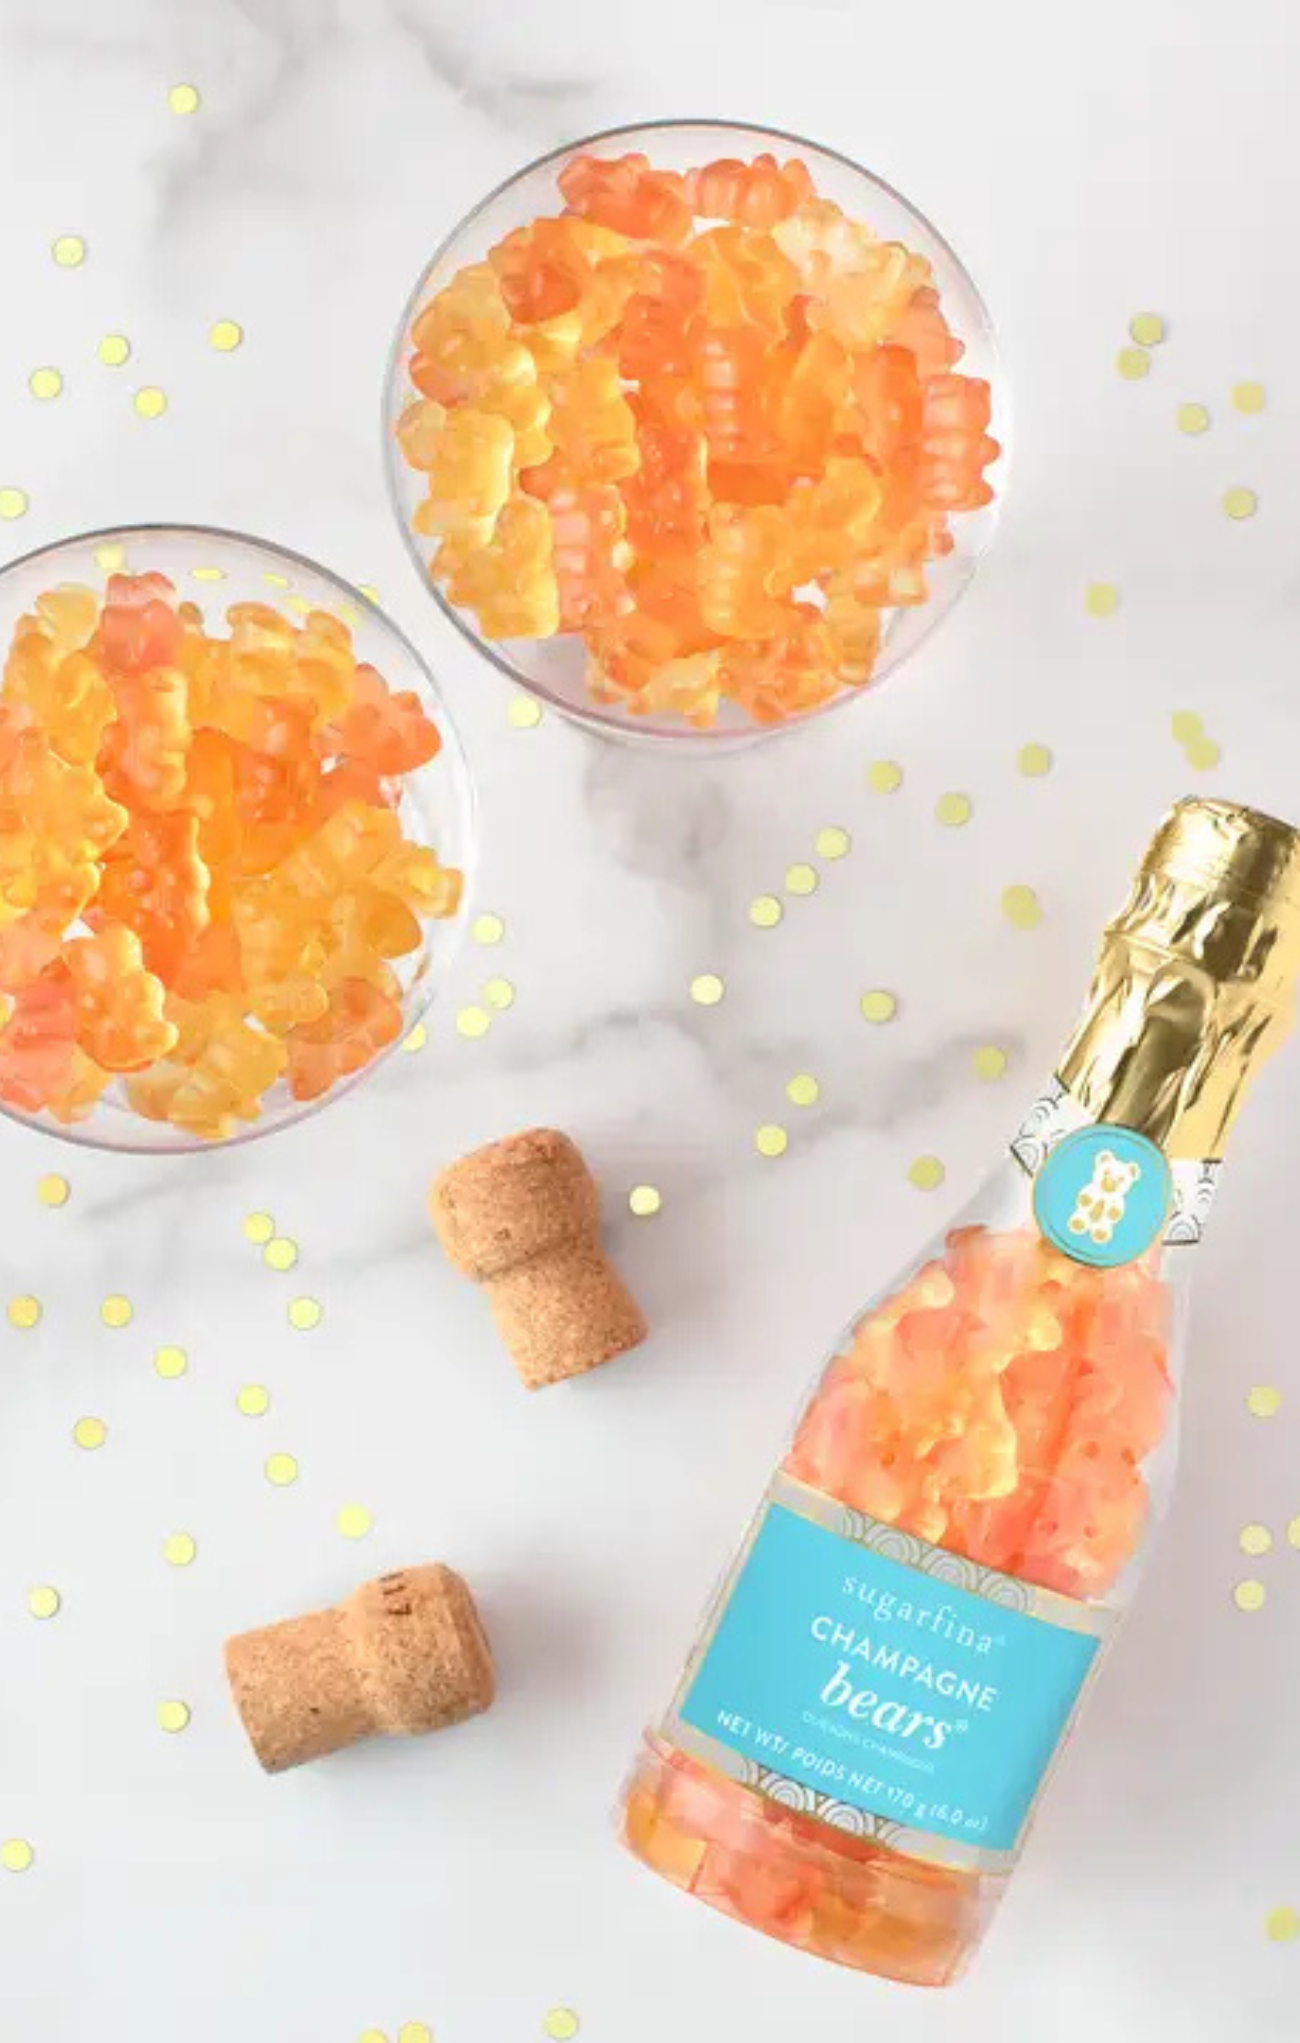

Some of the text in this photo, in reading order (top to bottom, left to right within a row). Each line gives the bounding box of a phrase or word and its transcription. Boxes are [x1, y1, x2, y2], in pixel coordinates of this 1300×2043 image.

[842, 1576, 992, 1652] sugarfina
[811, 1616, 997, 1712] CHAMPAGNE
[717, 1710, 751, 1737] NET
[791, 1747, 844, 1781] POIDS
[849, 1772, 883, 1796] NET
[887, 1786, 914, 1808] 170
